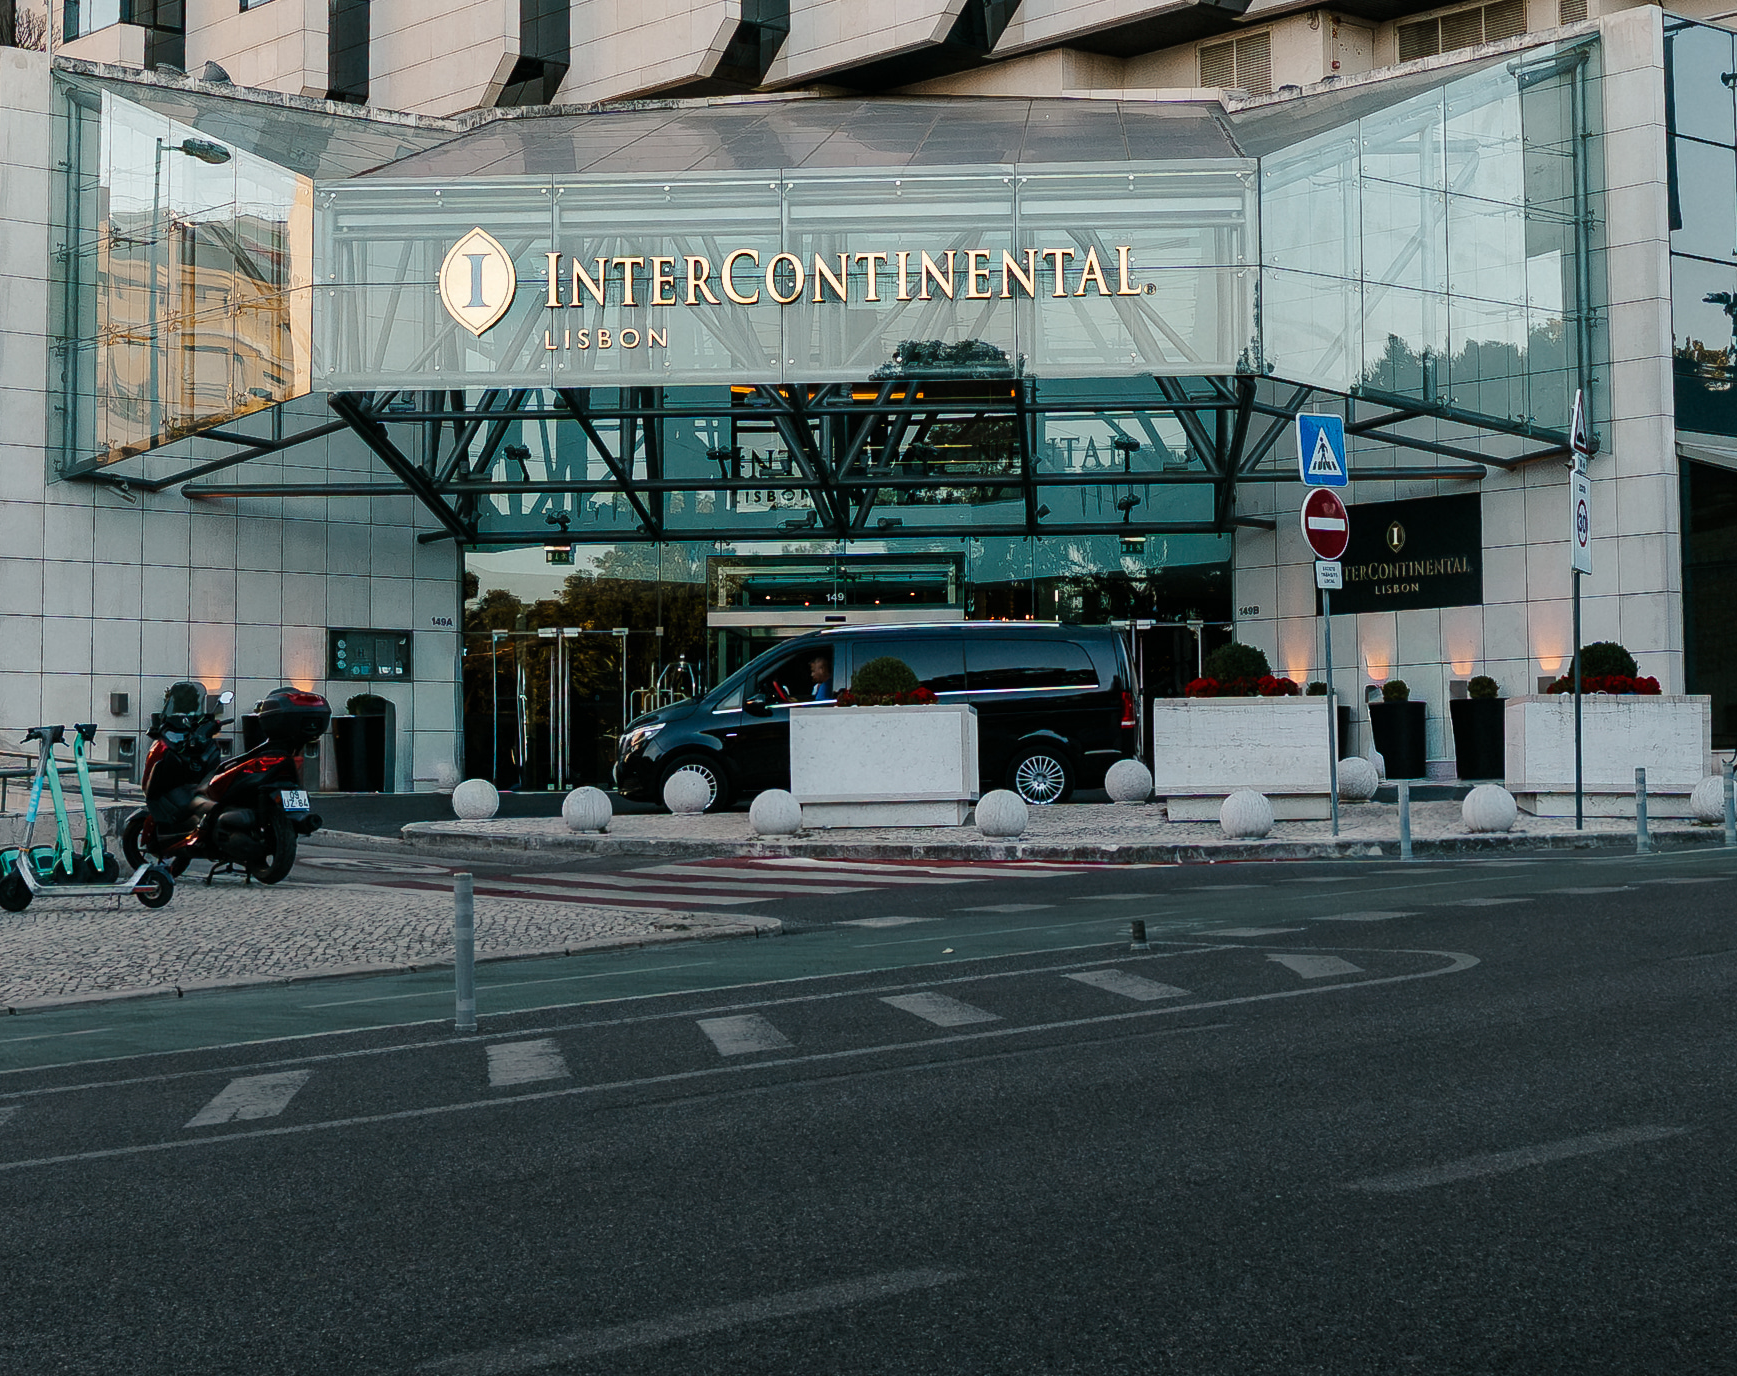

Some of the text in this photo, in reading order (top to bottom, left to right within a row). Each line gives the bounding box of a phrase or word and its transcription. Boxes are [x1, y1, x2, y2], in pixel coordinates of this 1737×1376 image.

[544, 326, 669, 351] LISBON
[1375, 582, 1419, 595] LISBON
[825, 592, 845, 602] 149
[1238, 605, 1260, 616] 149B
[431, 616, 453, 627] 149A
